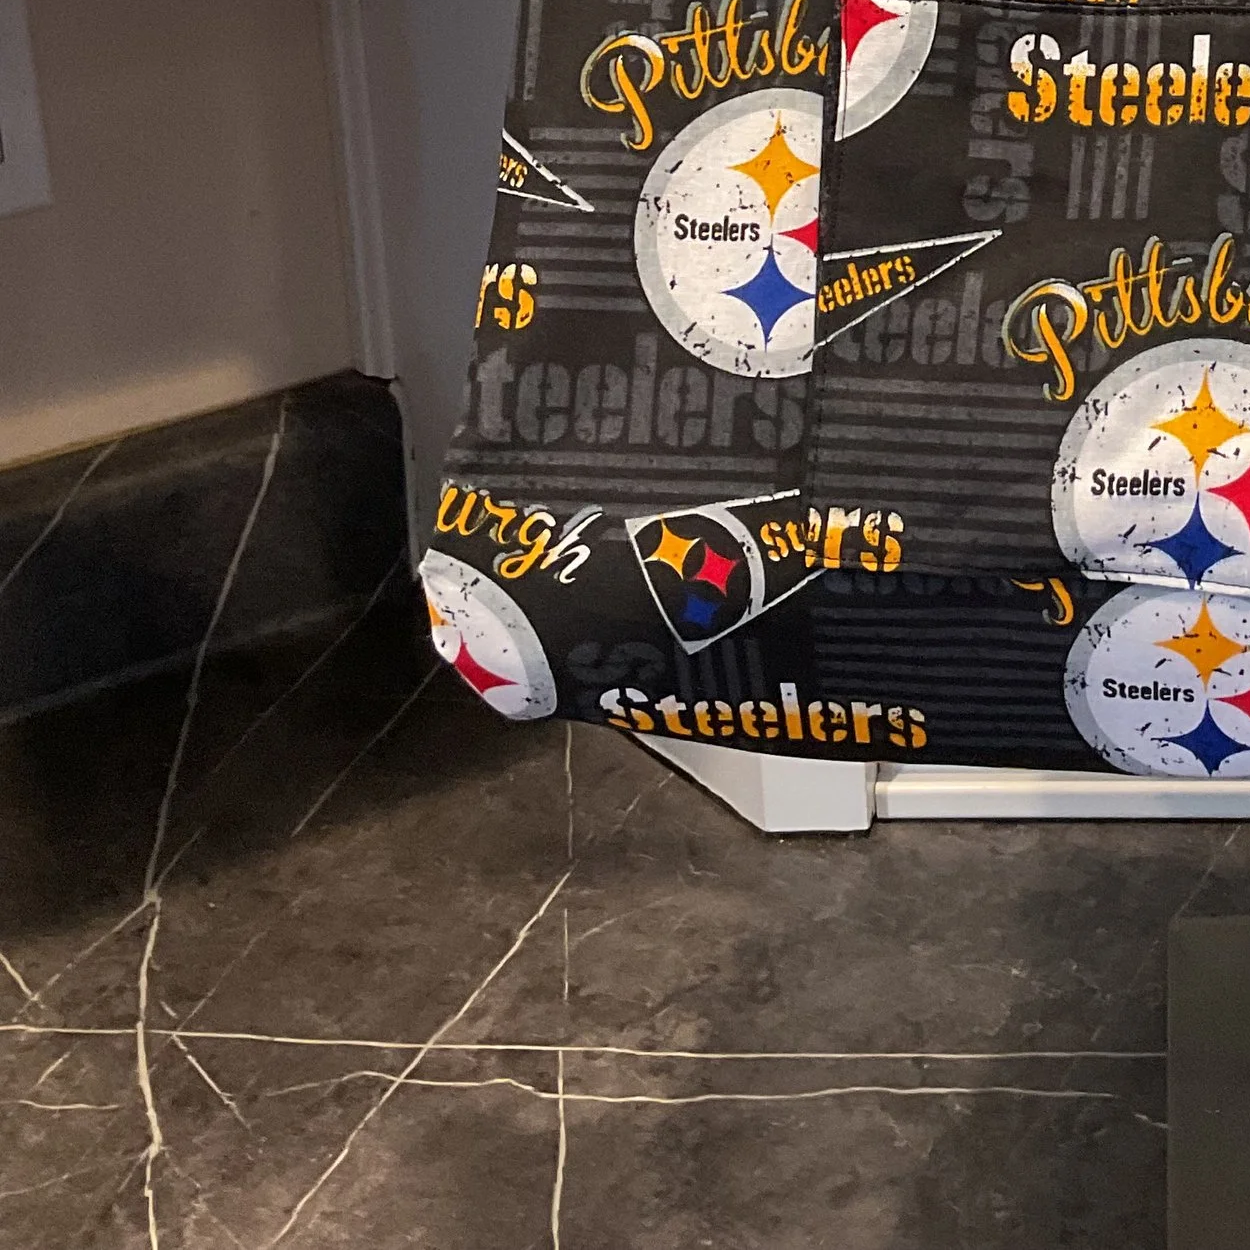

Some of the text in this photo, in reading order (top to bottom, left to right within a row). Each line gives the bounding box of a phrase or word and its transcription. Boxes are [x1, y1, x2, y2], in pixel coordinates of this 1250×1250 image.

[674, 214, 760, 243] Steelers
[1091, 468, 1186, 498] Steelers
[1103, 677, 1195, 703] Steelers
[599, 682, 928, 749] Steelers
